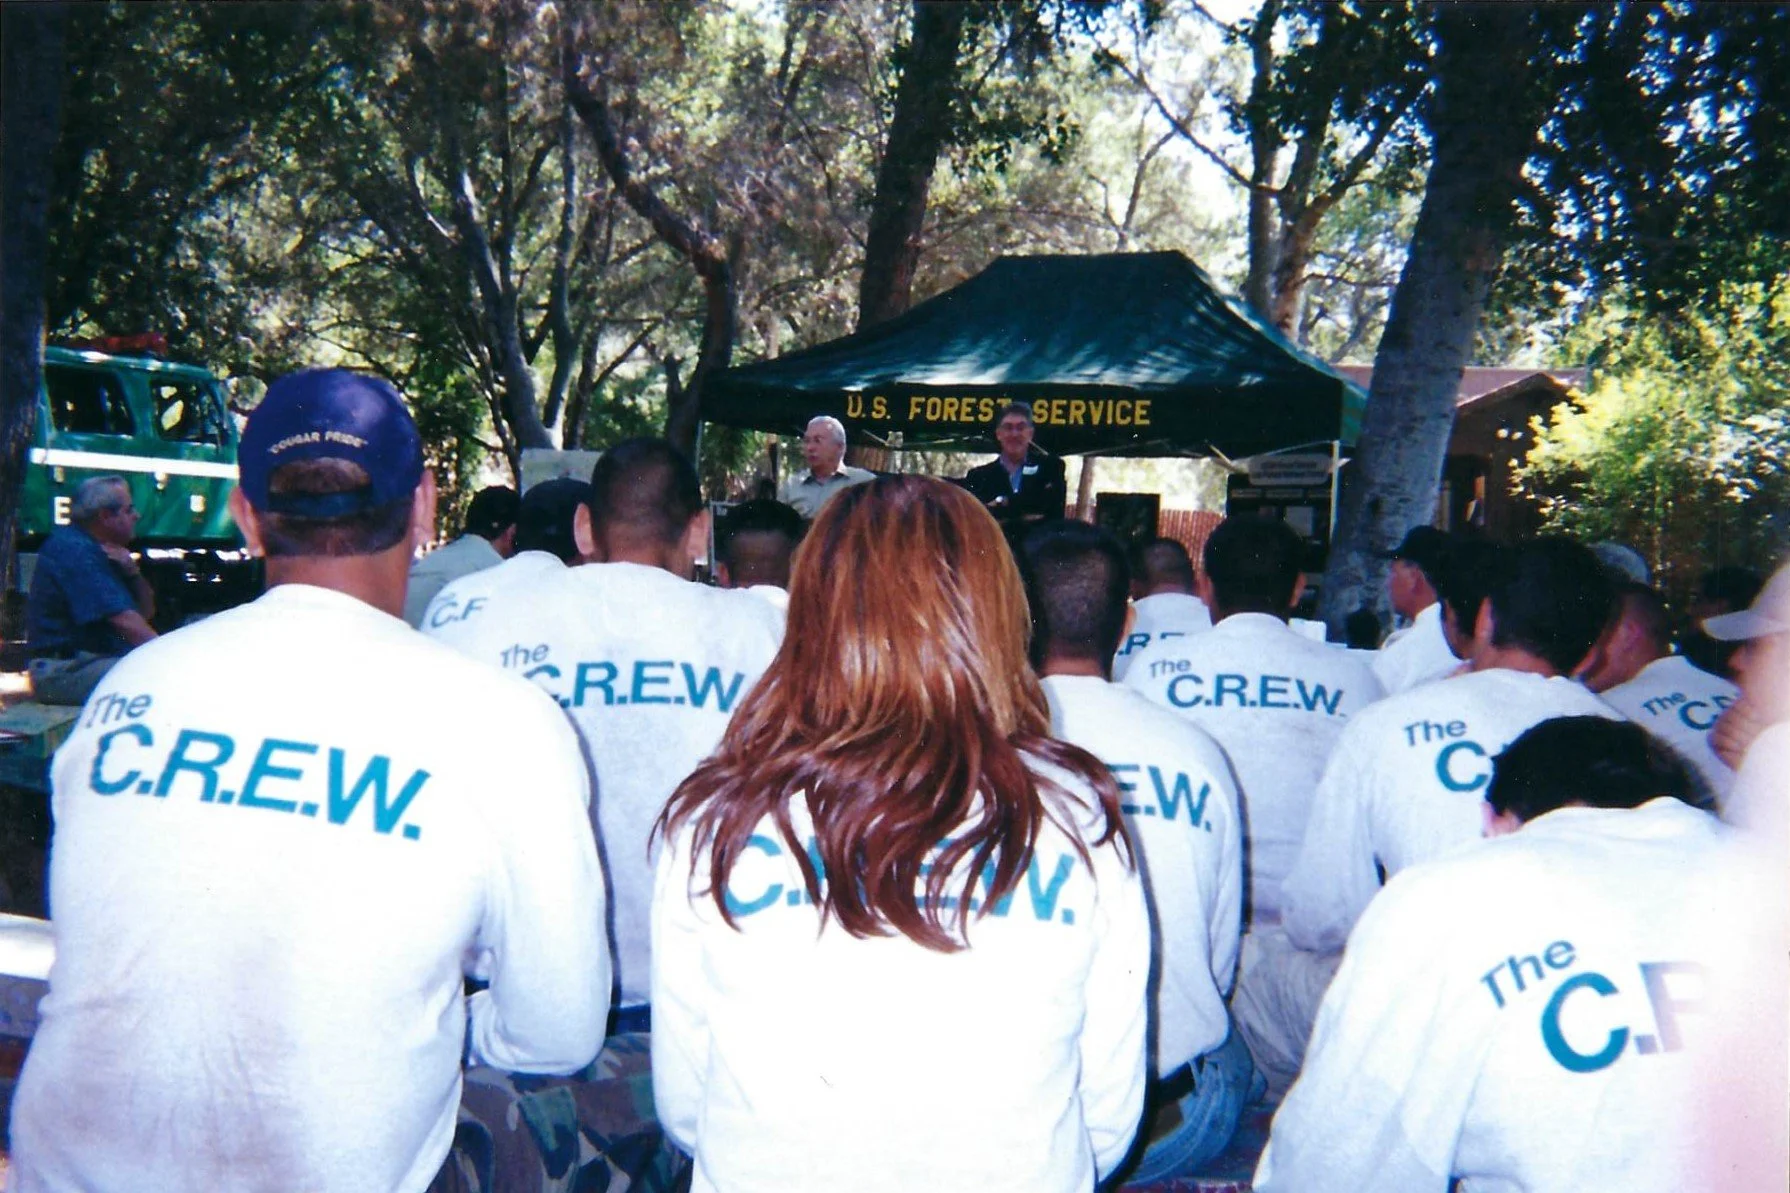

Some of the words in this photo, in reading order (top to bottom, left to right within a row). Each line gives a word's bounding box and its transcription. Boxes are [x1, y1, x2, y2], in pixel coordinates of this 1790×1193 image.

[847, 396, 891, 419] U.S.
[1032, 399, 1150, 425] SERVICE
[500, 644, 549, 667] The
[1150, 658, 1191, 678] The
[87, 691, 153, 728] The
[1643, 692, 1687, 716] The
[1404, 719, 1467, 746] The
[90, 723, 431, 840] C.R.E.W.
[1480, 940, 1576, 1009] The
